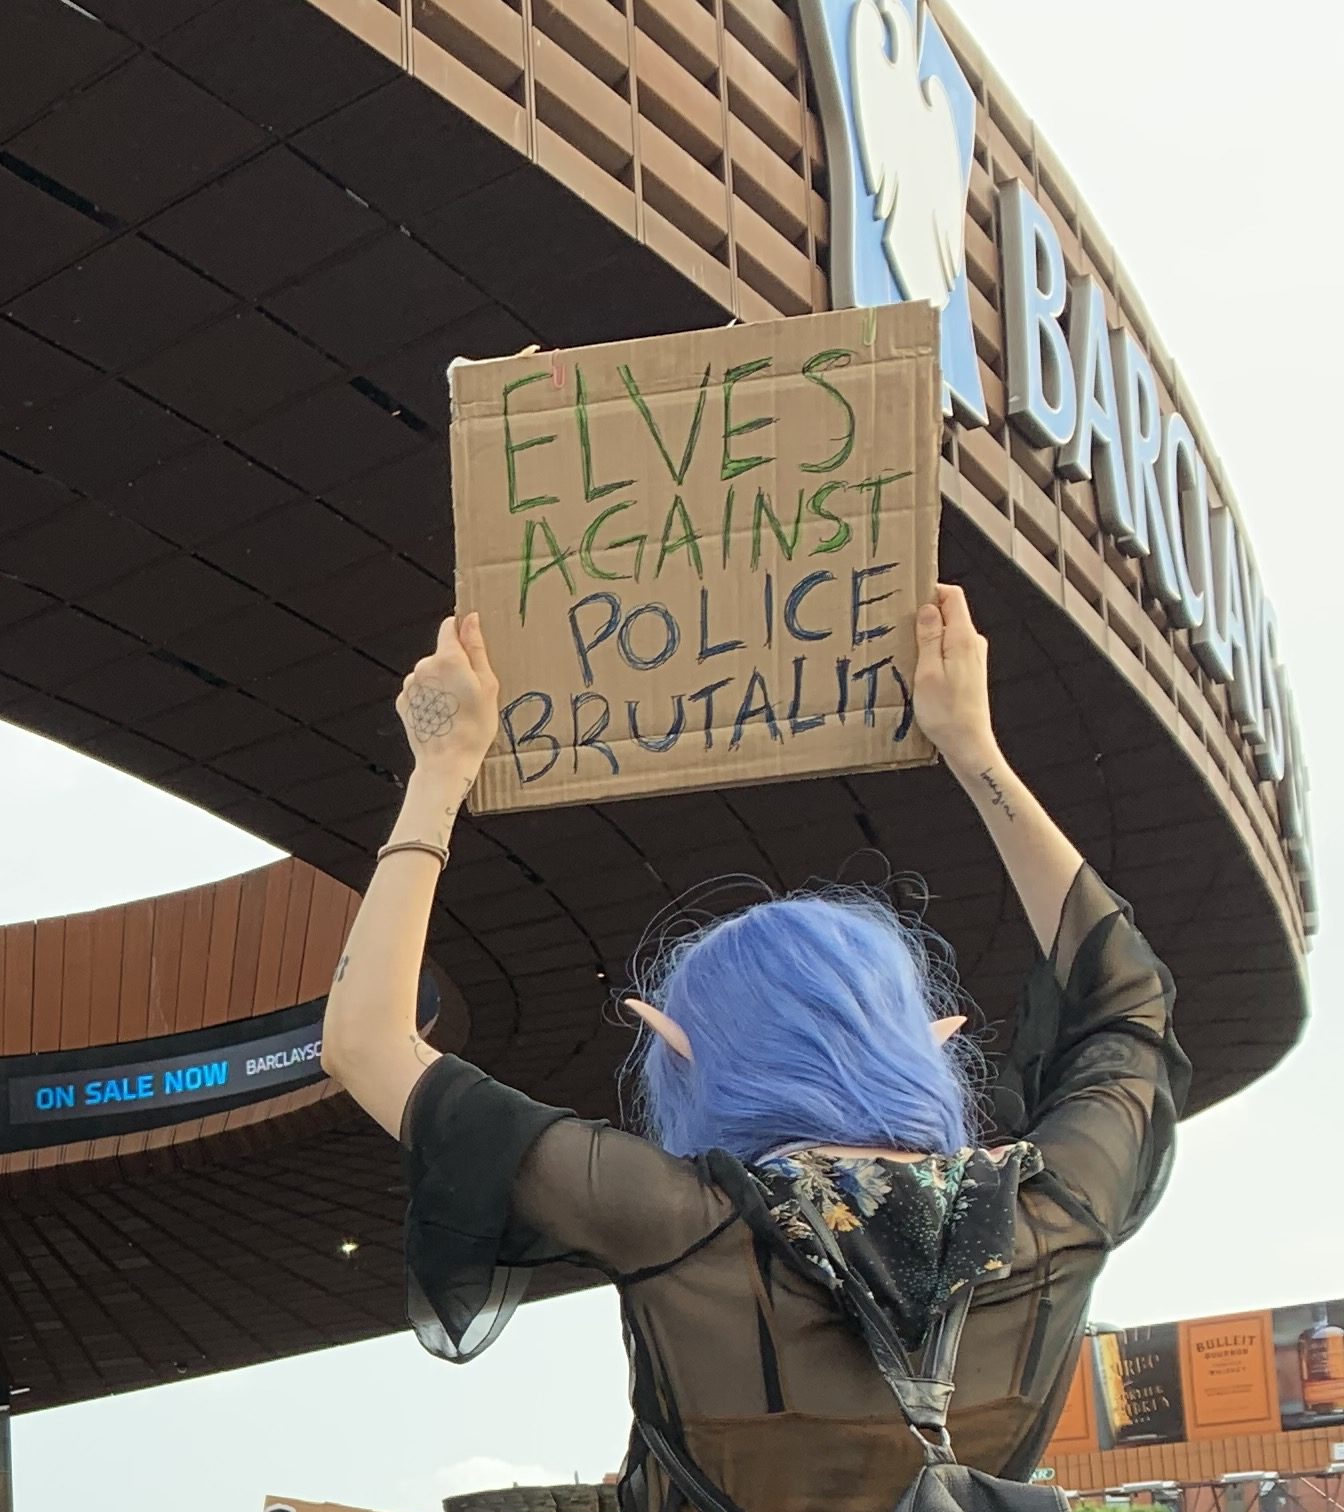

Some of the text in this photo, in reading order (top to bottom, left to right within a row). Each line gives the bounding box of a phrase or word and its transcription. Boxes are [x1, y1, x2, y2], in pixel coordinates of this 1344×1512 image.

[503, 348, 858, 513] ELVES
[998, 177, 1285, 782] BARCLAYS
[518, 470, 913, 627] AGAINST
[568, 562, 901, 686] POLICE
[35, 1061, 229, 1111] ON SALE NOW
[1195, 1335, 1257, 1353] BULLEIT
